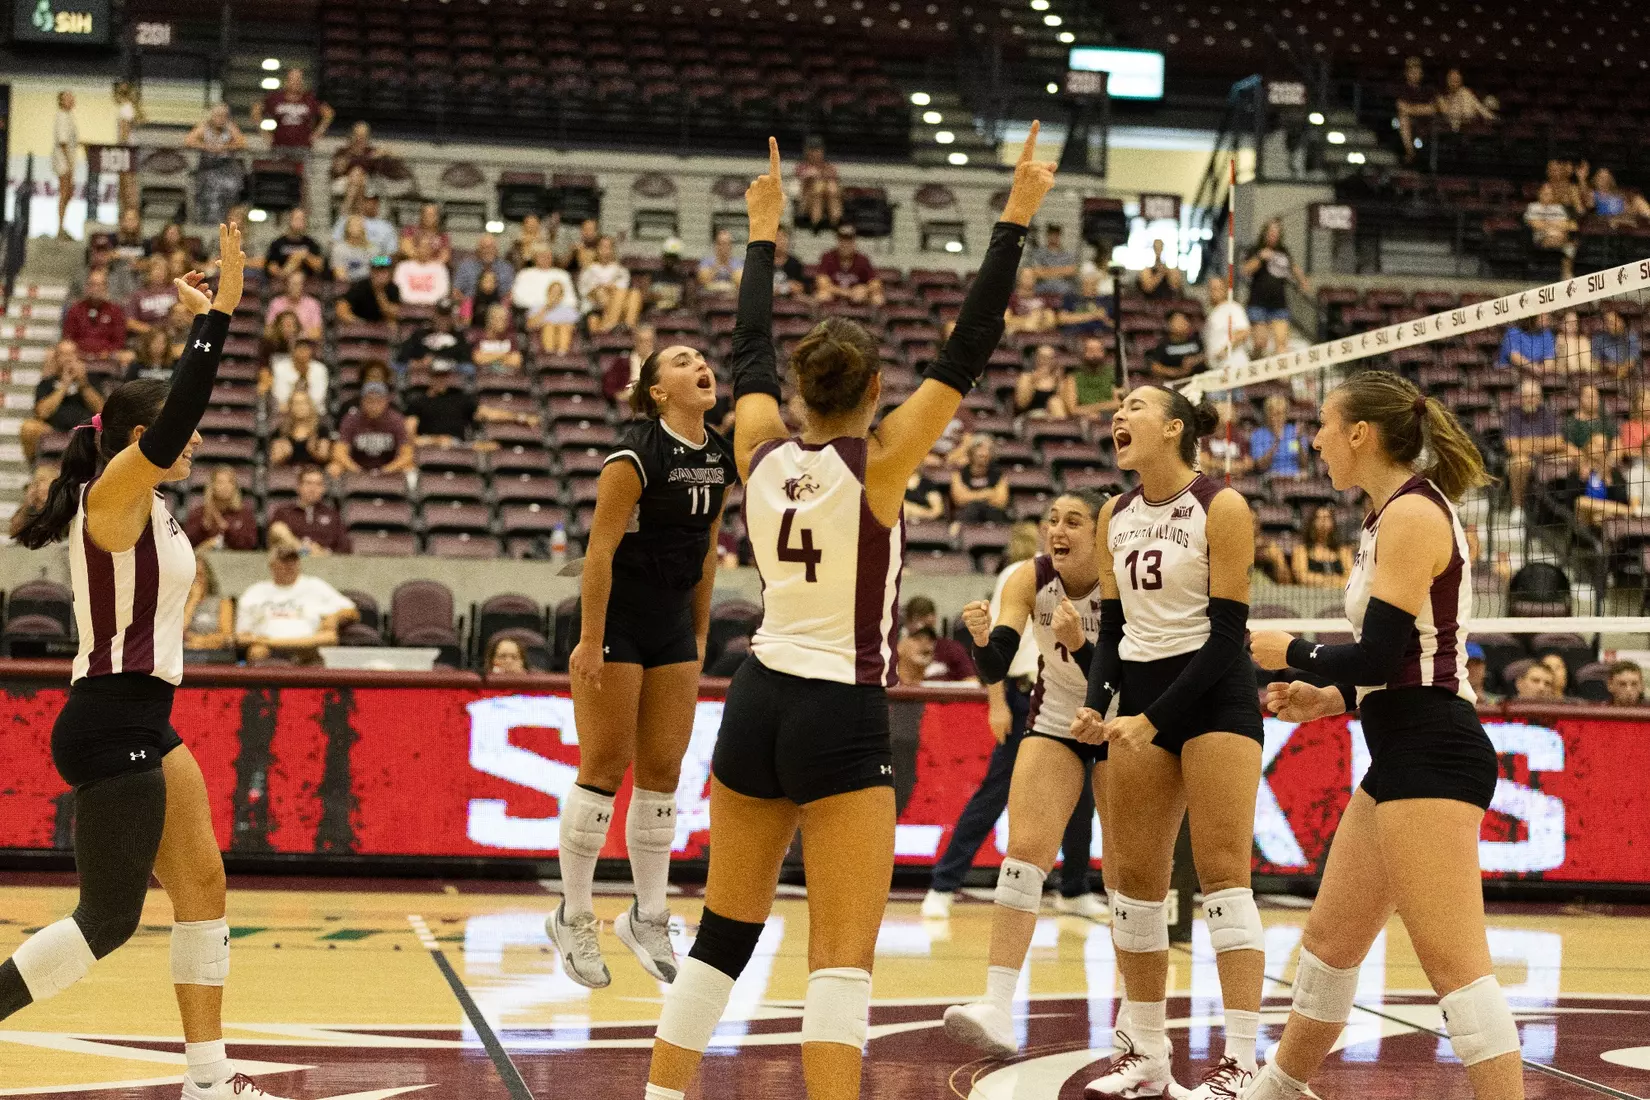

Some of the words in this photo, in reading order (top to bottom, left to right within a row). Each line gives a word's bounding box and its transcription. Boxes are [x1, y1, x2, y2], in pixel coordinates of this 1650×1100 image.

[1375, 332, 1389, 345] SIU
[1413, 321, 1426, 337] SIU
[1452, 310, 1467, 327] SIU
[1493, 298, 1509, 316] SIU
[1538, 286, 1555, 304] SIU
[1587, 273, 1605, 293] SIU
[668, 467, 724, 484] SALUKIS
[688, 485, 710, 515] 11
[777, 508, 822, 583] 4
[1125, 549, 1163, 590] 13
